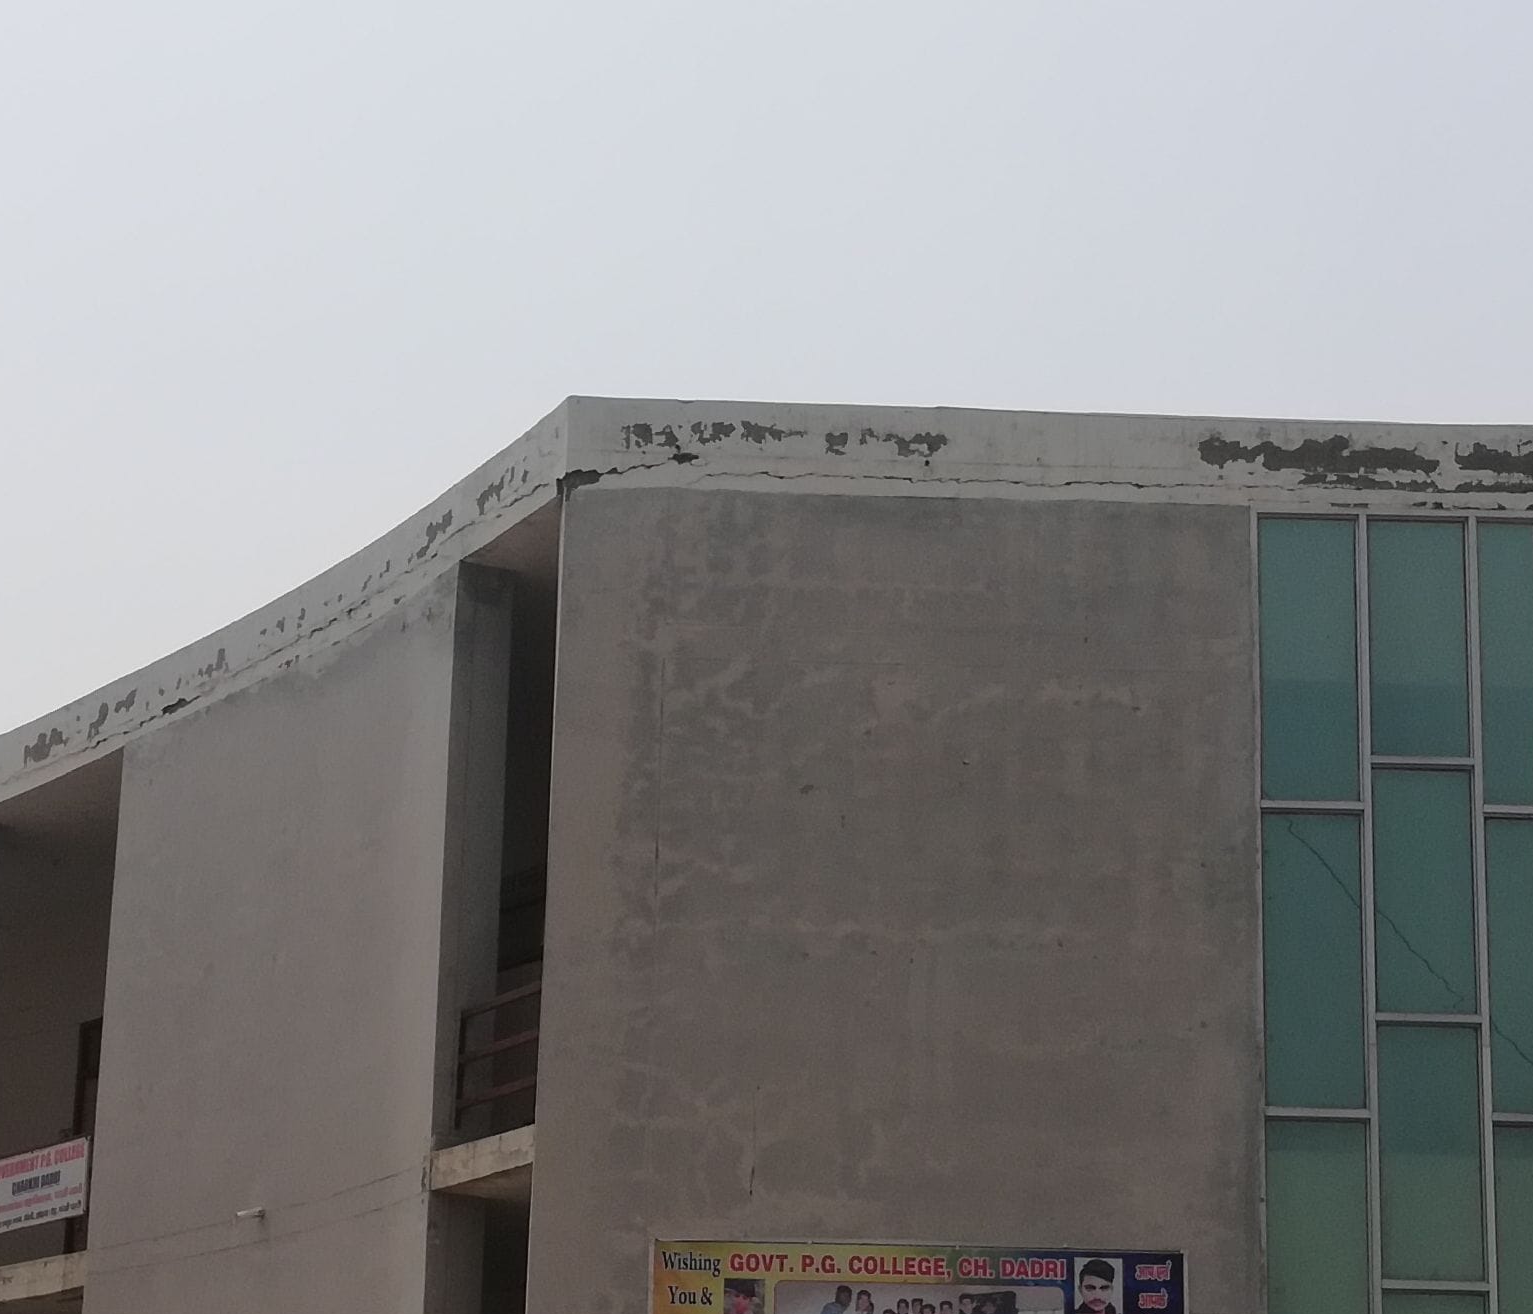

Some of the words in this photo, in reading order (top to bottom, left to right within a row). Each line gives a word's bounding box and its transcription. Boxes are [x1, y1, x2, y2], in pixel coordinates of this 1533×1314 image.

[662, 1251, 721, 1277] Wishing
[729, 1253, 794, 1272] GOVT.
[801, 1255, 842, 1274] P.G.
[848, 1255, 952, 1279] COLLEGE,
[958, 1257, 994, 1278] CH.
[1000, 1258, 1067, 1279] DADRI
[668, 1286, 696, 1305] You
[700, 1287, 713, 1306] &
